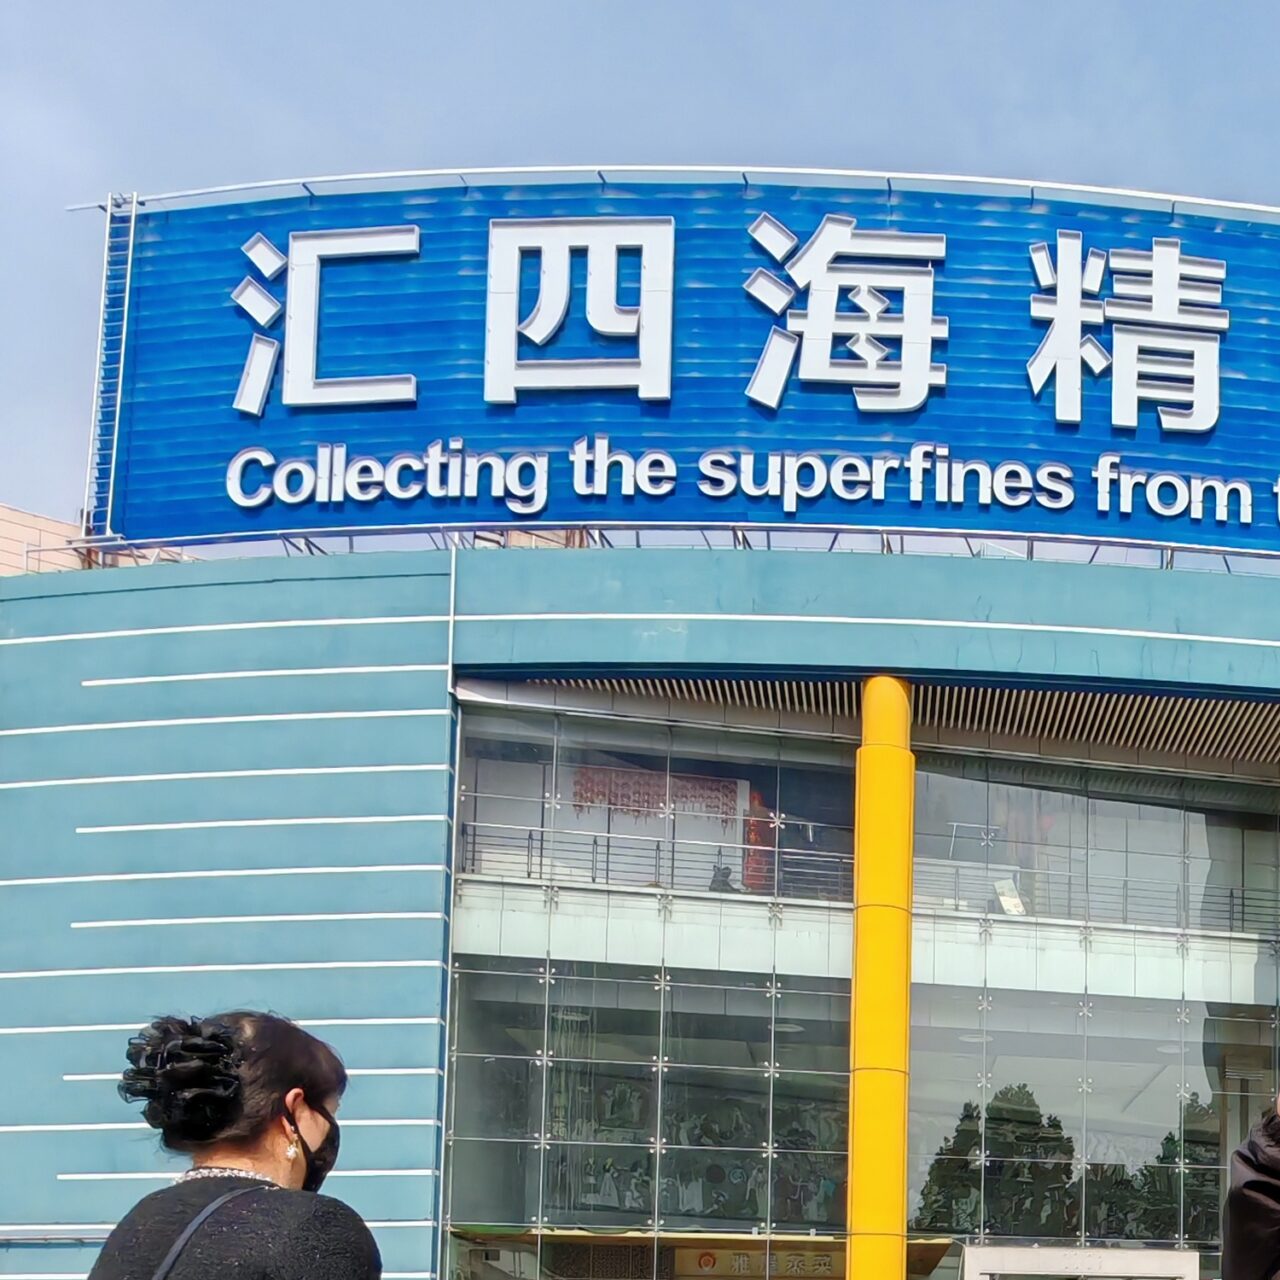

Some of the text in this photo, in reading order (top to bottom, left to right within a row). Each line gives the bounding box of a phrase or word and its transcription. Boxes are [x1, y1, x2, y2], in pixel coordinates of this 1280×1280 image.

[226, 437, 548, 514] Collecting
[570, 433, 677, 496] the
[697, 441, 1075, 512] superfines
[1091, 451, 1253, 524] from
